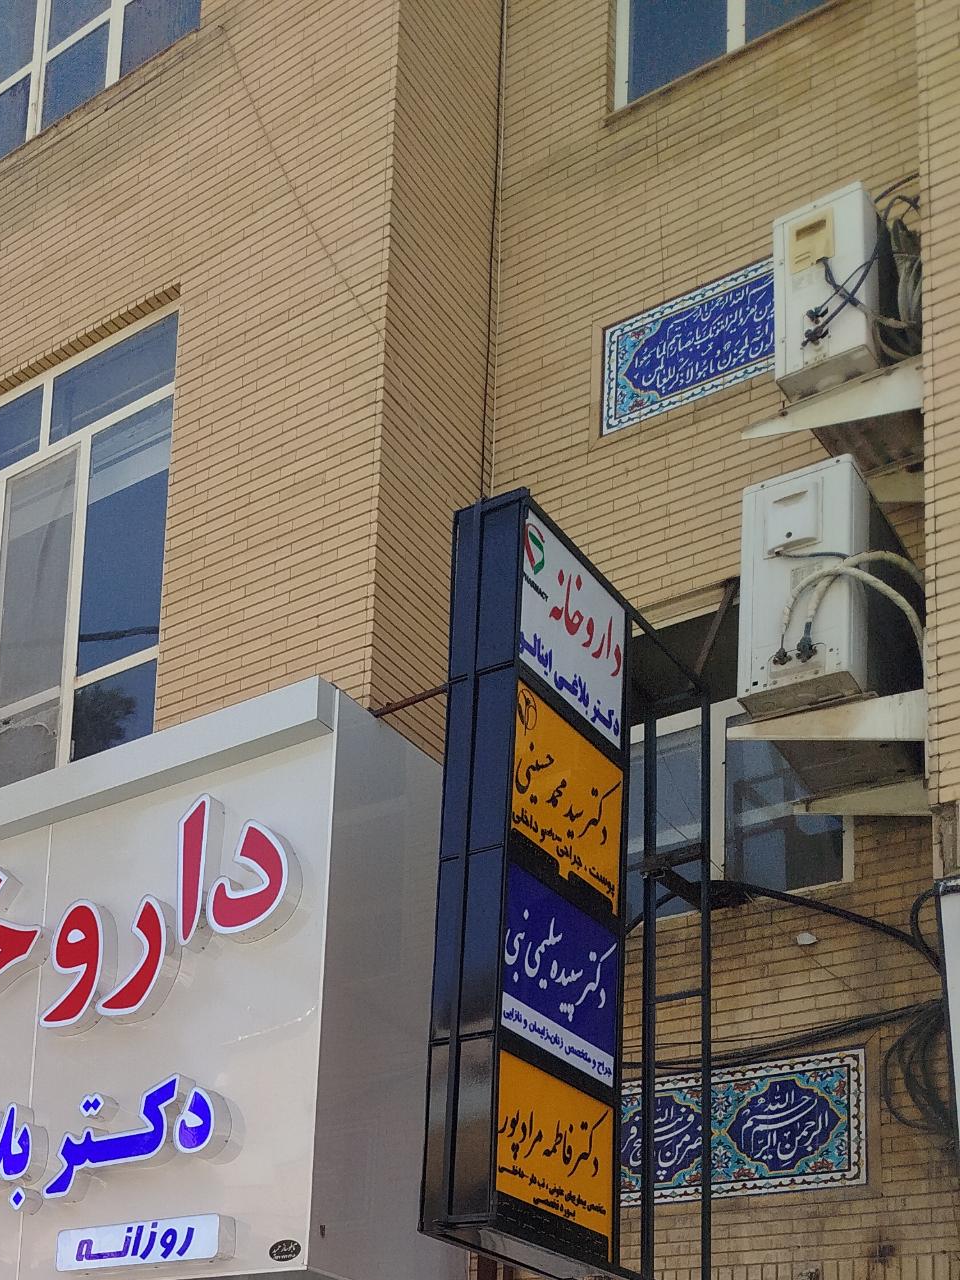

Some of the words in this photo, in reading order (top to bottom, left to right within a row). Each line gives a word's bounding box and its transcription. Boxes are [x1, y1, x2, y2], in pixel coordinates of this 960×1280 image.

[549, 569, 622, 677] داروخانه
[519, 631, 553, 676] اینالو
[554, 672, 589, 715] بلاغی
[591, 699, 620, 738] دکتر
[515, 742, 554, 805] حسینی
[563, 804, 584, 840] سید
[578, 781, 621, 846] دکتر
[575, 942, 618, 1009] دکتر
[502, 1008, 524, 1025] نازایی
[523, 1018, 529, 1029] و
[565, 1043, 592, 1065] متخصص
[598, 1061, 613, 1078] جراح
[44, 1077, 212, 1198] دکتر
[543, 1119, 573, 1165] فاطمه
[567, 1109, 609, 1178] دکتر
[75, 1220, 194, 1262] روزانه
